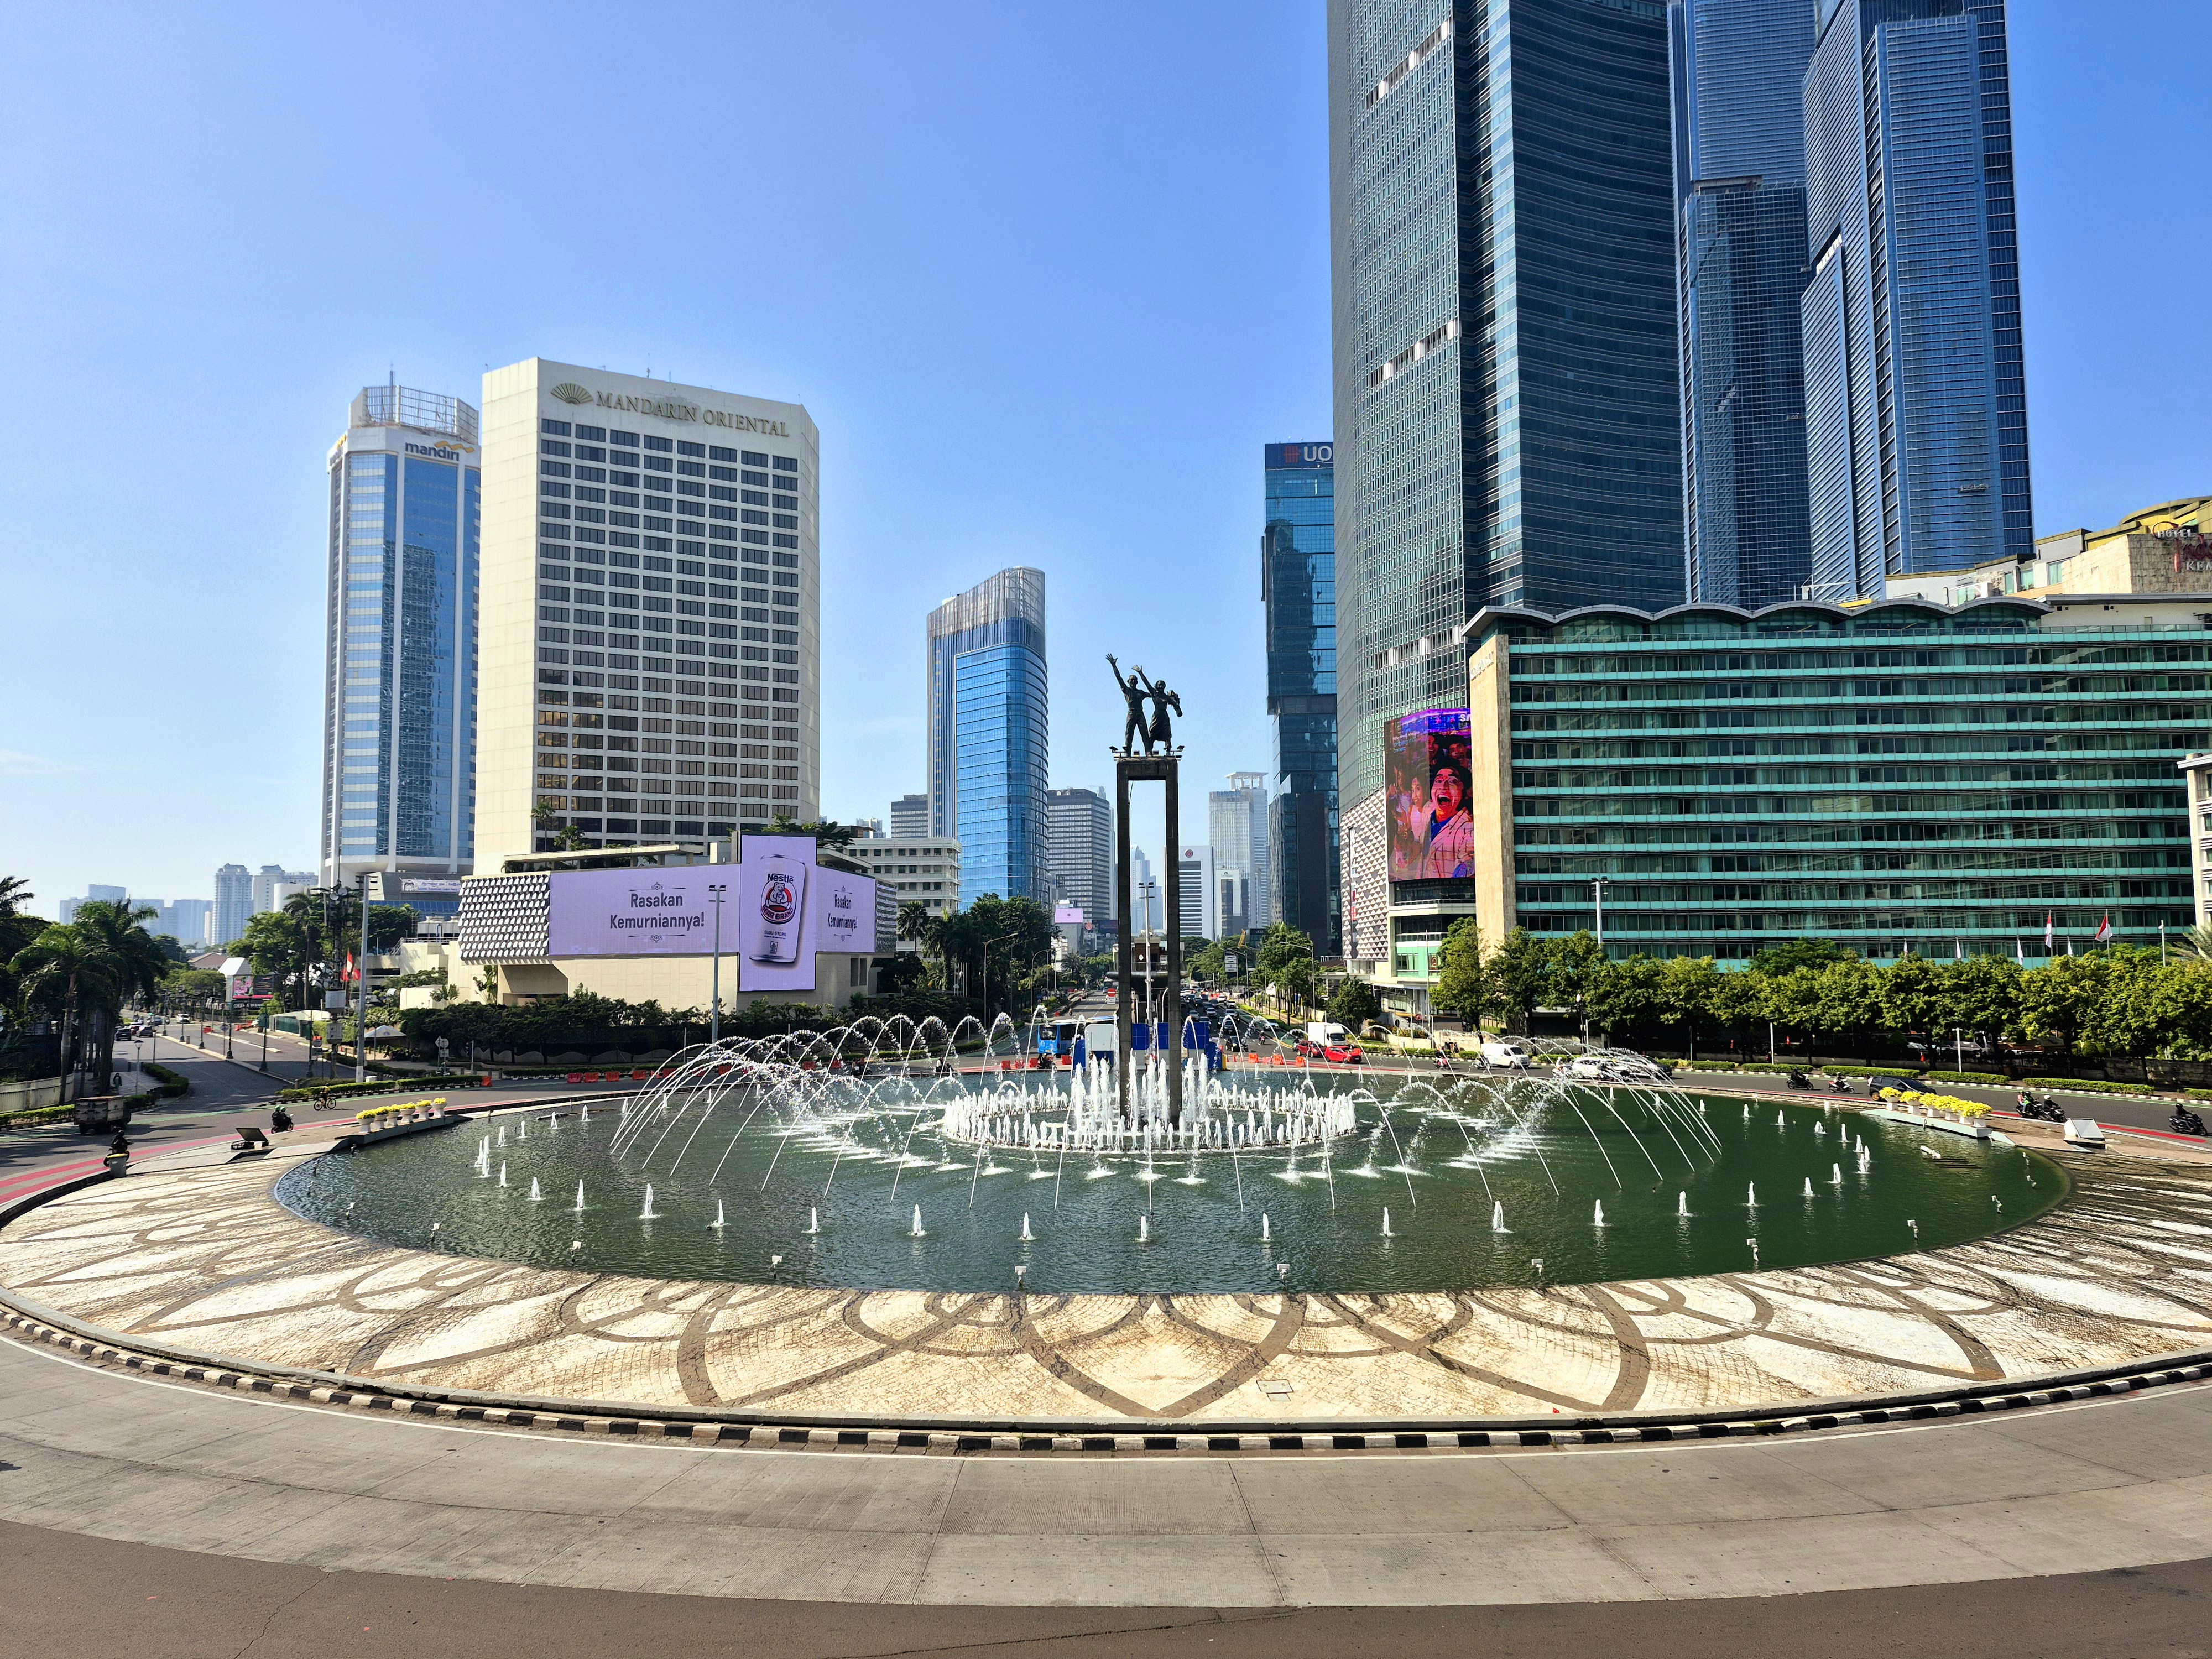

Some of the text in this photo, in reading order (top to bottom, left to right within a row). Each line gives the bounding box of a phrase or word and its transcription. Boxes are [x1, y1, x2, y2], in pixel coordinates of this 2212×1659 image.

[597, 391, 790, 437] MANDARIN ORIENTAL
[405, 442, 460, 461] mandiri
[1303, 445, 1333, 462] UO
[2157, 528, 2196, 539] HOTEL
[1460, 713, 1471, 722] SA
[630, 891, 683, 908] Rasakan
[834, 894, 852, 910] Rasakan
[609, 911, 705, 931] Kemurniannya!
[762, 905, 794, 920] BEAR BRAND
[827, 912, 858, 932] Kemurniannya!
